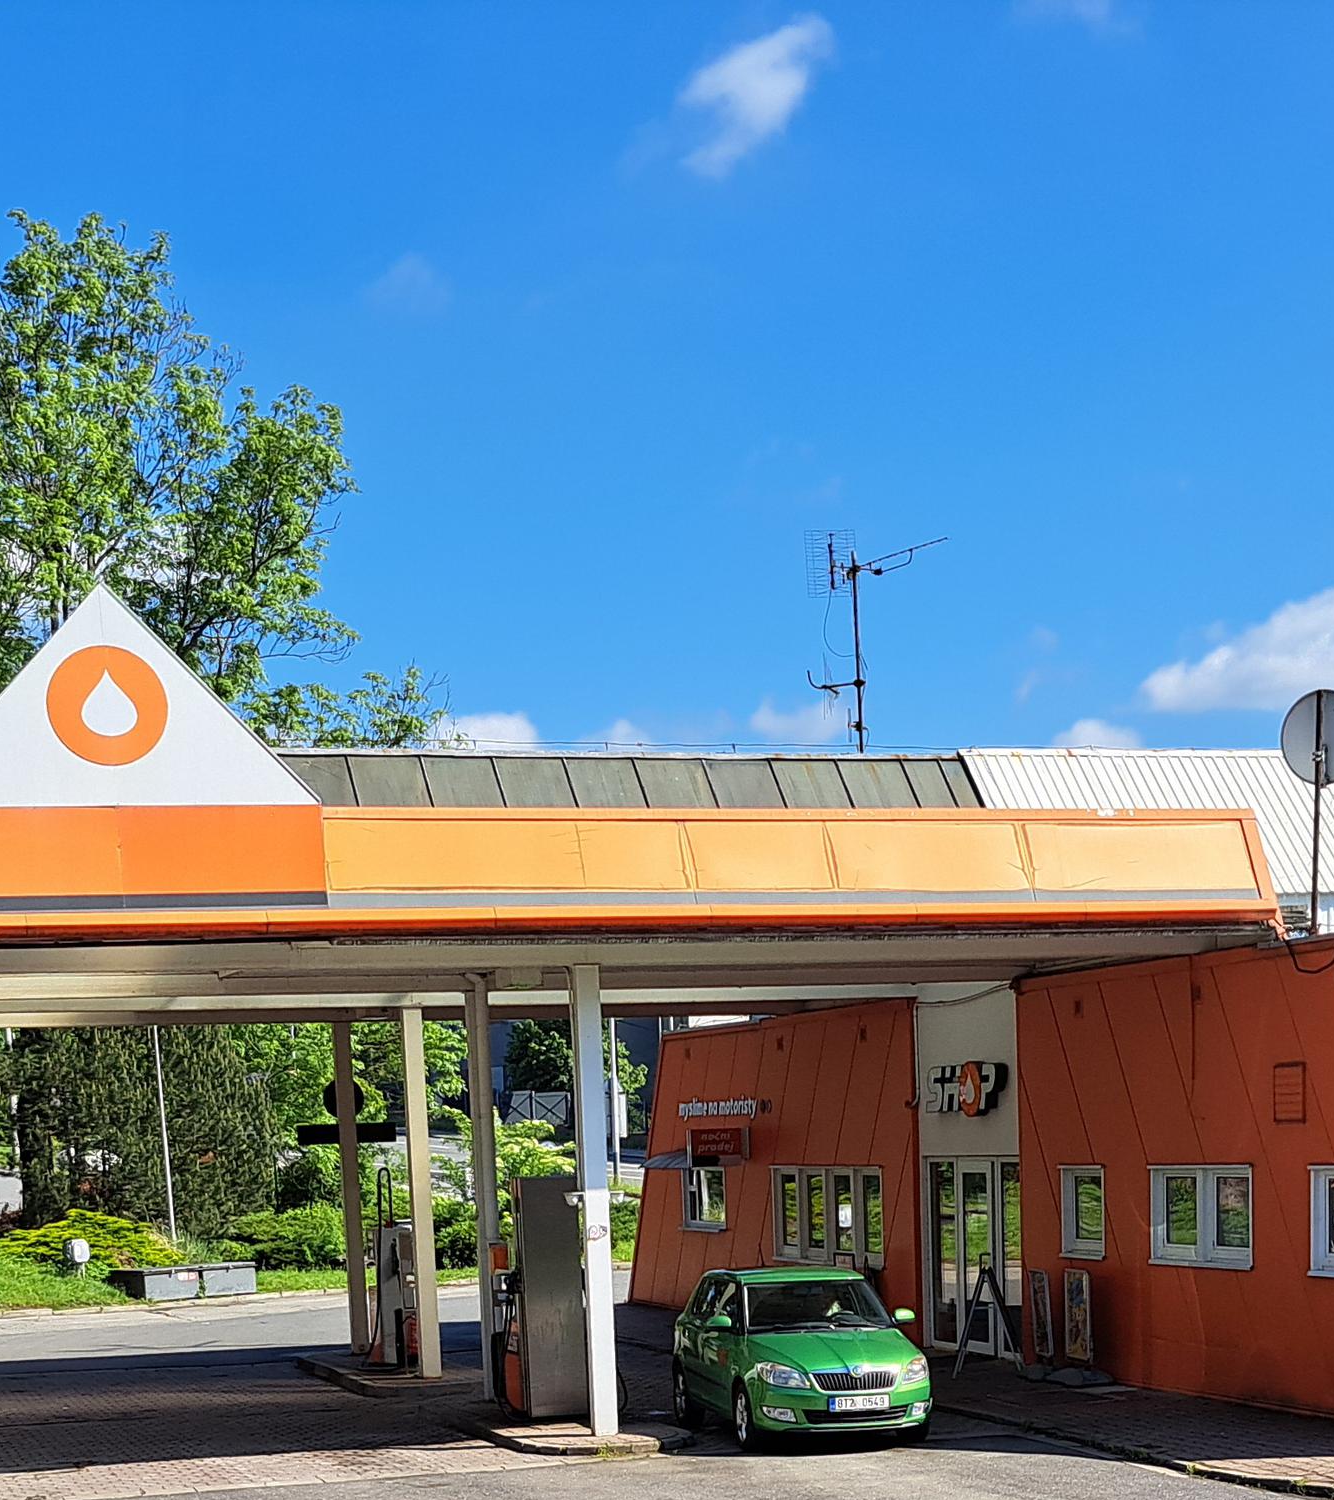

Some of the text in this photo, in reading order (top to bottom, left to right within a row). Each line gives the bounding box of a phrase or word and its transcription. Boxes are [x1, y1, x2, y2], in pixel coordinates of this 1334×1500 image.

[926, 1062, 997, 1117] SHOP
[708, 1101, 718, 1116] na
[719, 1094, 758, 1120] motoristy
[697, 1141, 735, 1155] prodej
[862, 1396, 886, 1408] 0549
